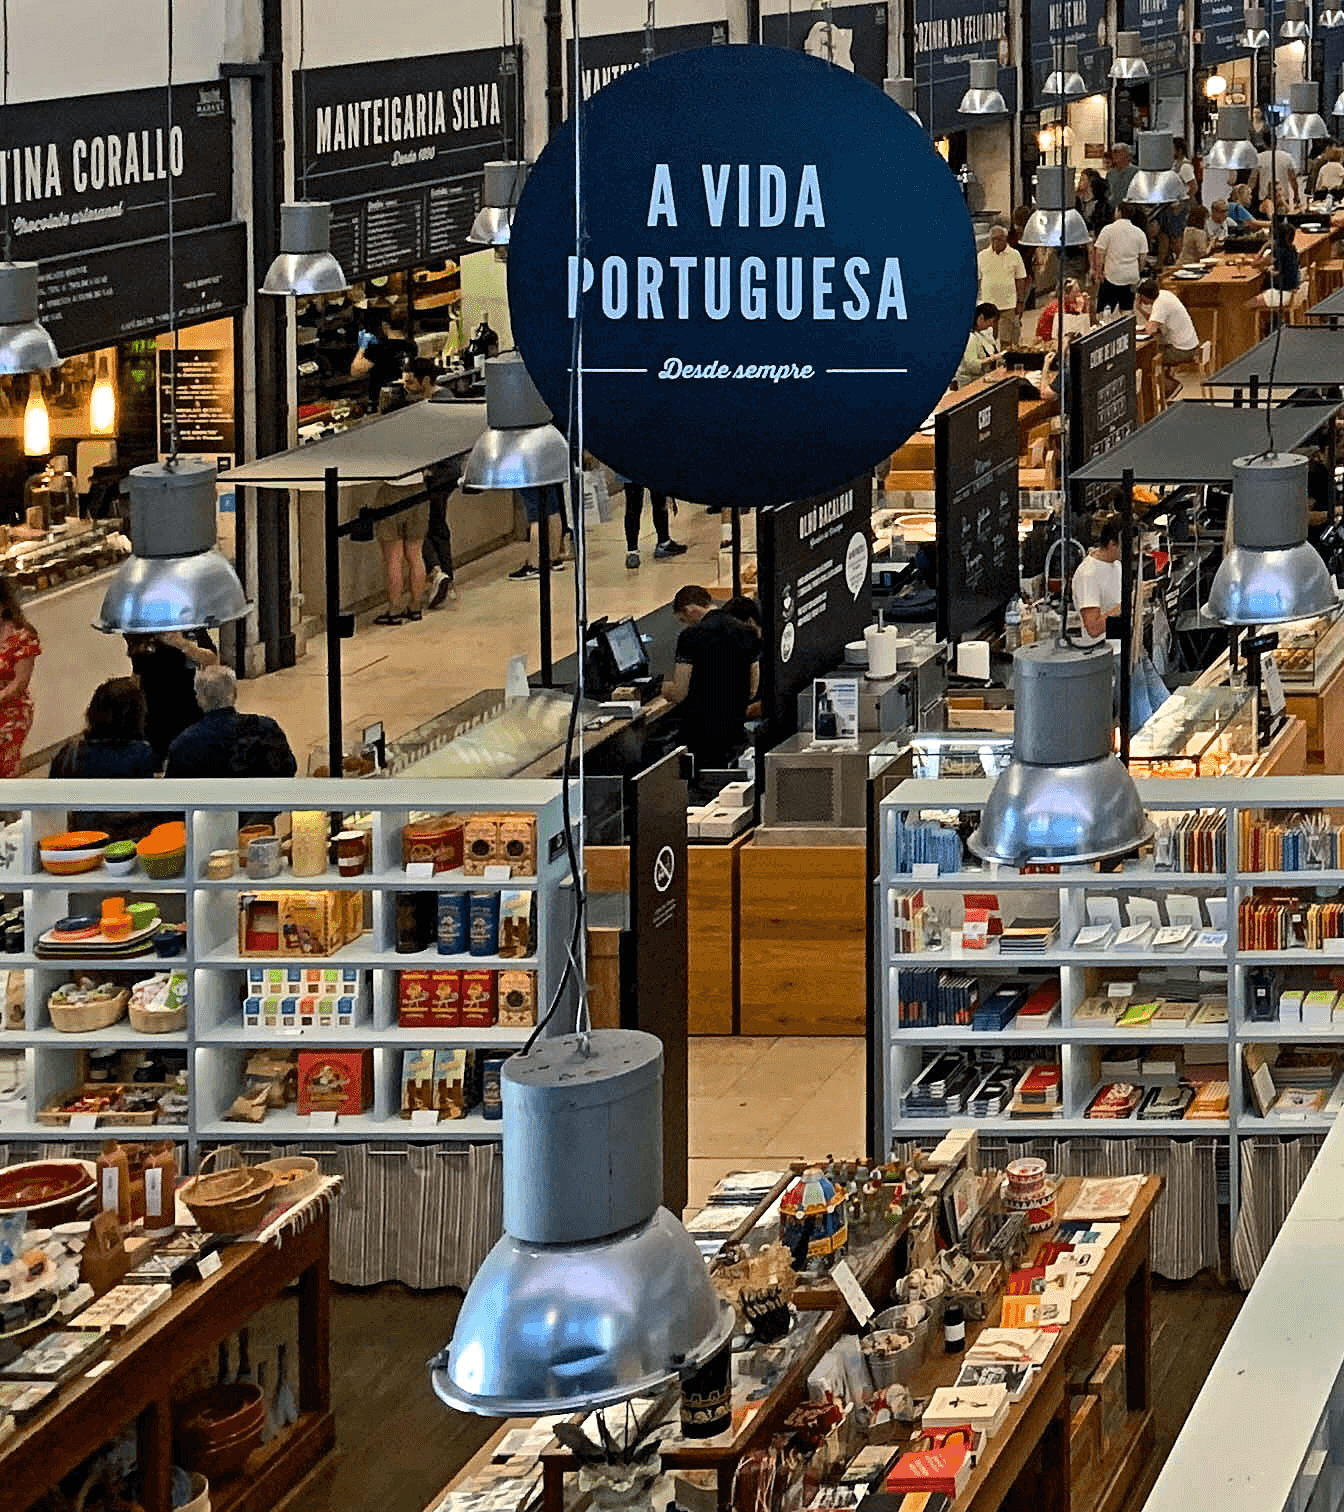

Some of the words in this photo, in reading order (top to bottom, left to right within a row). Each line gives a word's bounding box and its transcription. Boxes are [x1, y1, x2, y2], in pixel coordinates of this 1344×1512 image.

[316, 90, 446, 155] MANTEIGARIA
[452, 82, 501, 132] SILVA
[72, 125, 184, 193] CORALLO
[646, 164, 678, 227] A
[701, 164, 826, 228] VIDA
[567, 255, 908, 321] PORTUGUESA
[658, 357, 733, 381] Desde
[733, 362, 816, 383] sempre
